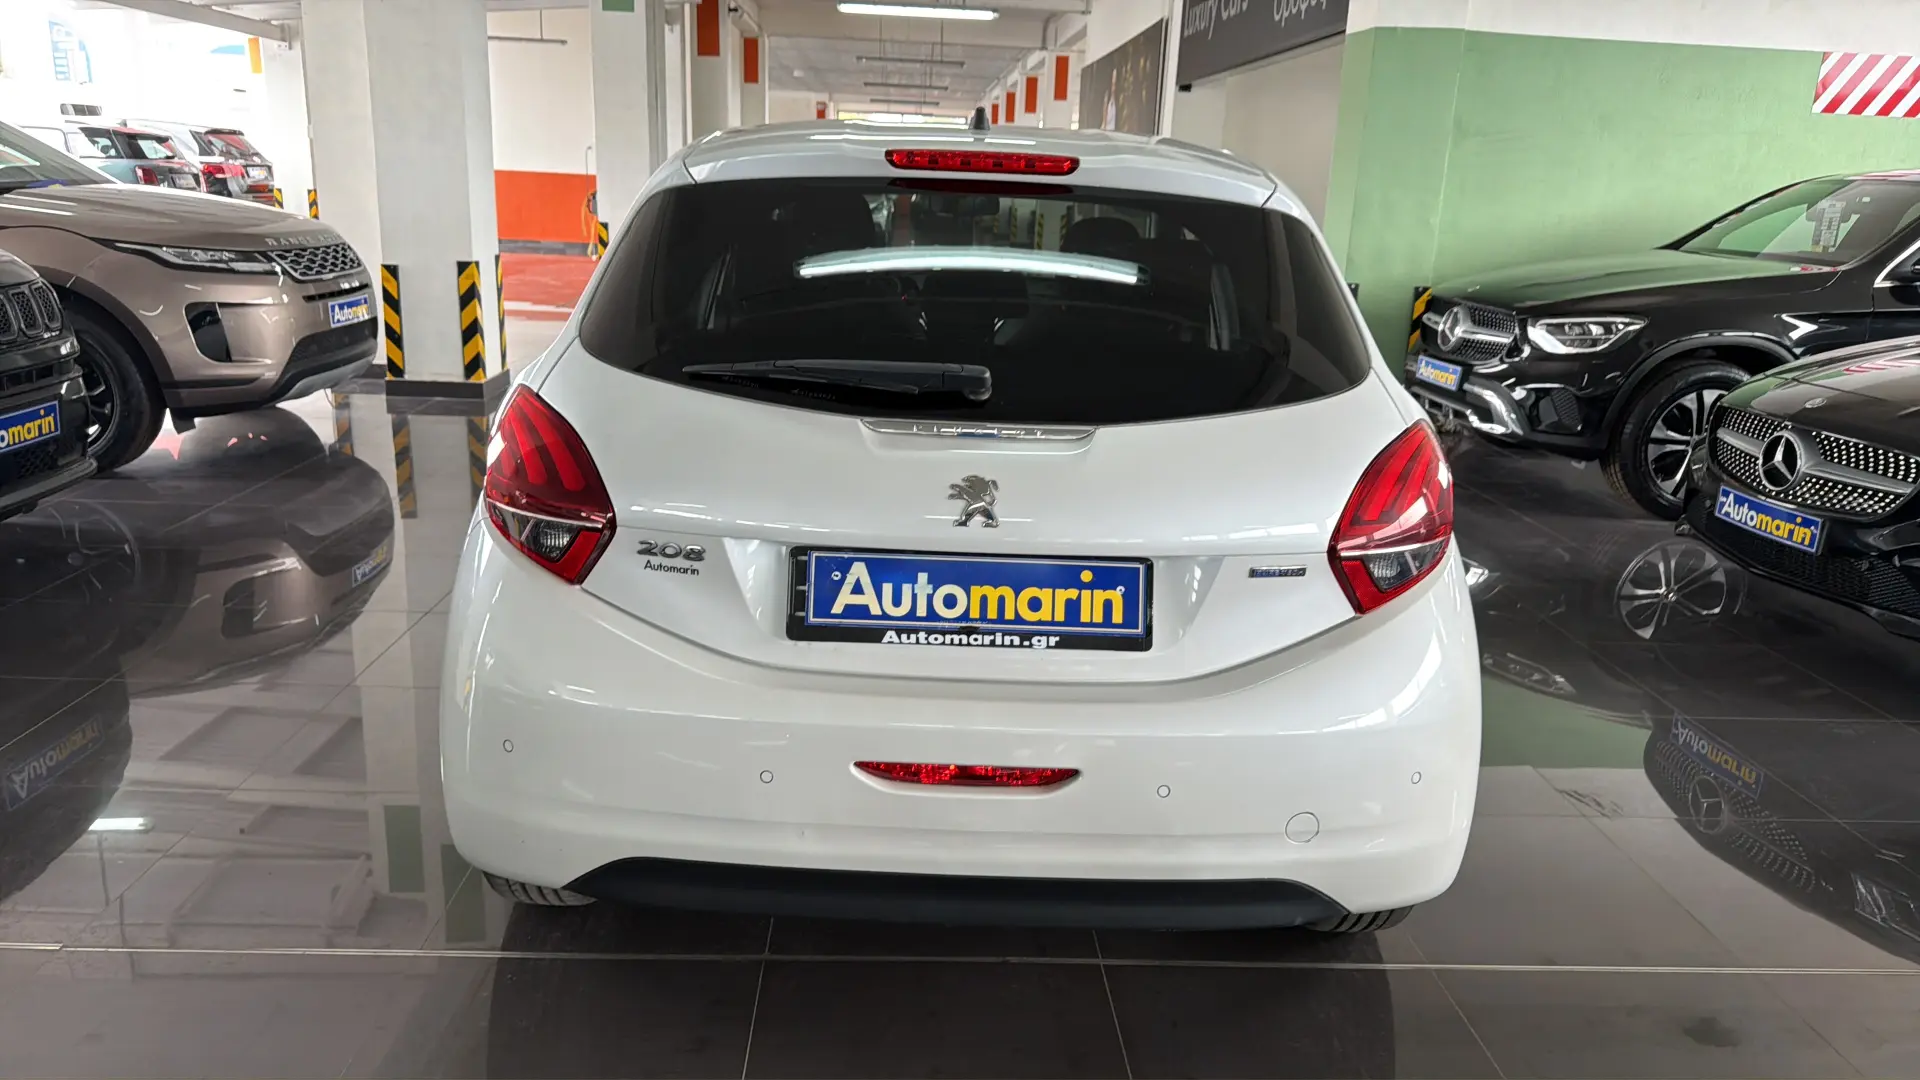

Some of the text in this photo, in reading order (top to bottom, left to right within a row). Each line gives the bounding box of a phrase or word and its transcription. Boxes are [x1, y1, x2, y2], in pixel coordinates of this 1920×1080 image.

[1721, 493, 1812, 546] Automarin
[636, 540, 706, 561] 208
[643, 560, 700, 576] Automarin
[830, 561, 1123, 624] Automarin
[881, 630, 1060, 648] Automarin.gr
